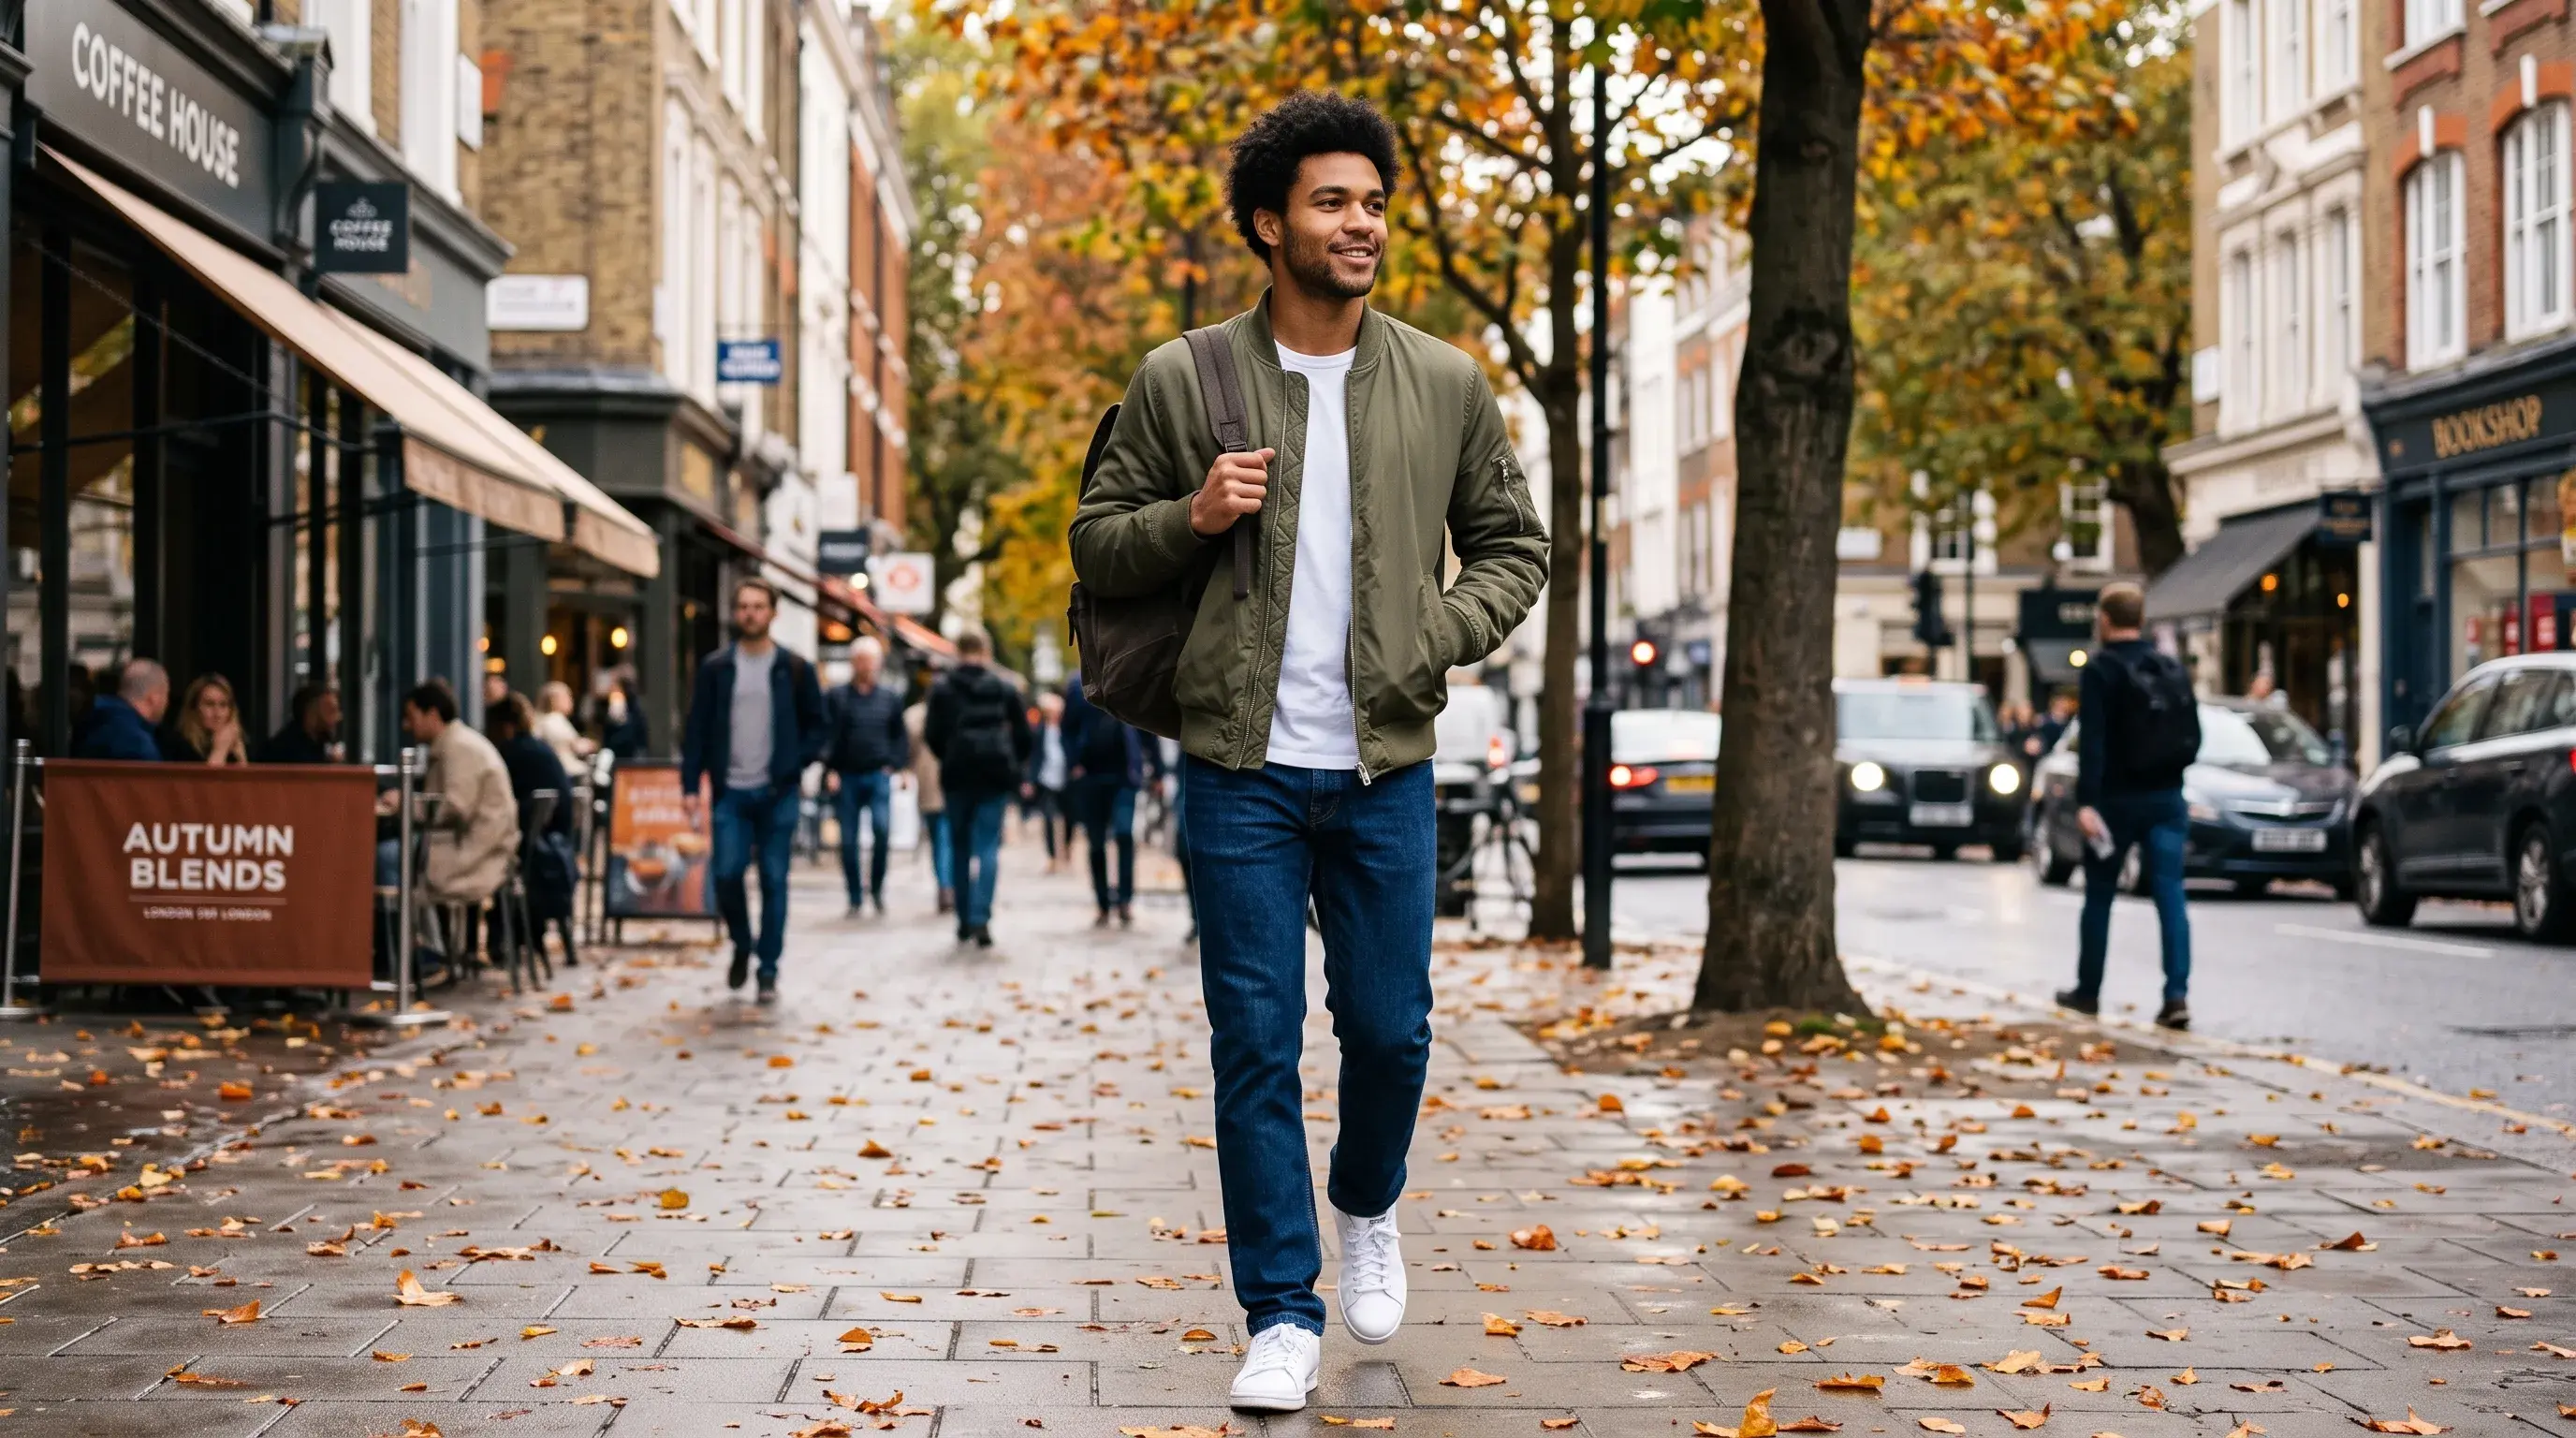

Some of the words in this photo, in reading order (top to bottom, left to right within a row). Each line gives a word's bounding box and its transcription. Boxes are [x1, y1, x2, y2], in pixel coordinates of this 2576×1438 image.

[71, 22, 165, 140] COFFEE
[169, 86, 240, 189] HOUSE
[329, 219, 393, 237] COFFEE
[333, 236, 389, 252] HOUSE
[2432, 394, 2542, 459] BOOKSHOP
[123, 822, 294, 857] AUTUMN
[130, 857, 287, 892] BLENDS
[143, 906, 194, 918] LONDON
